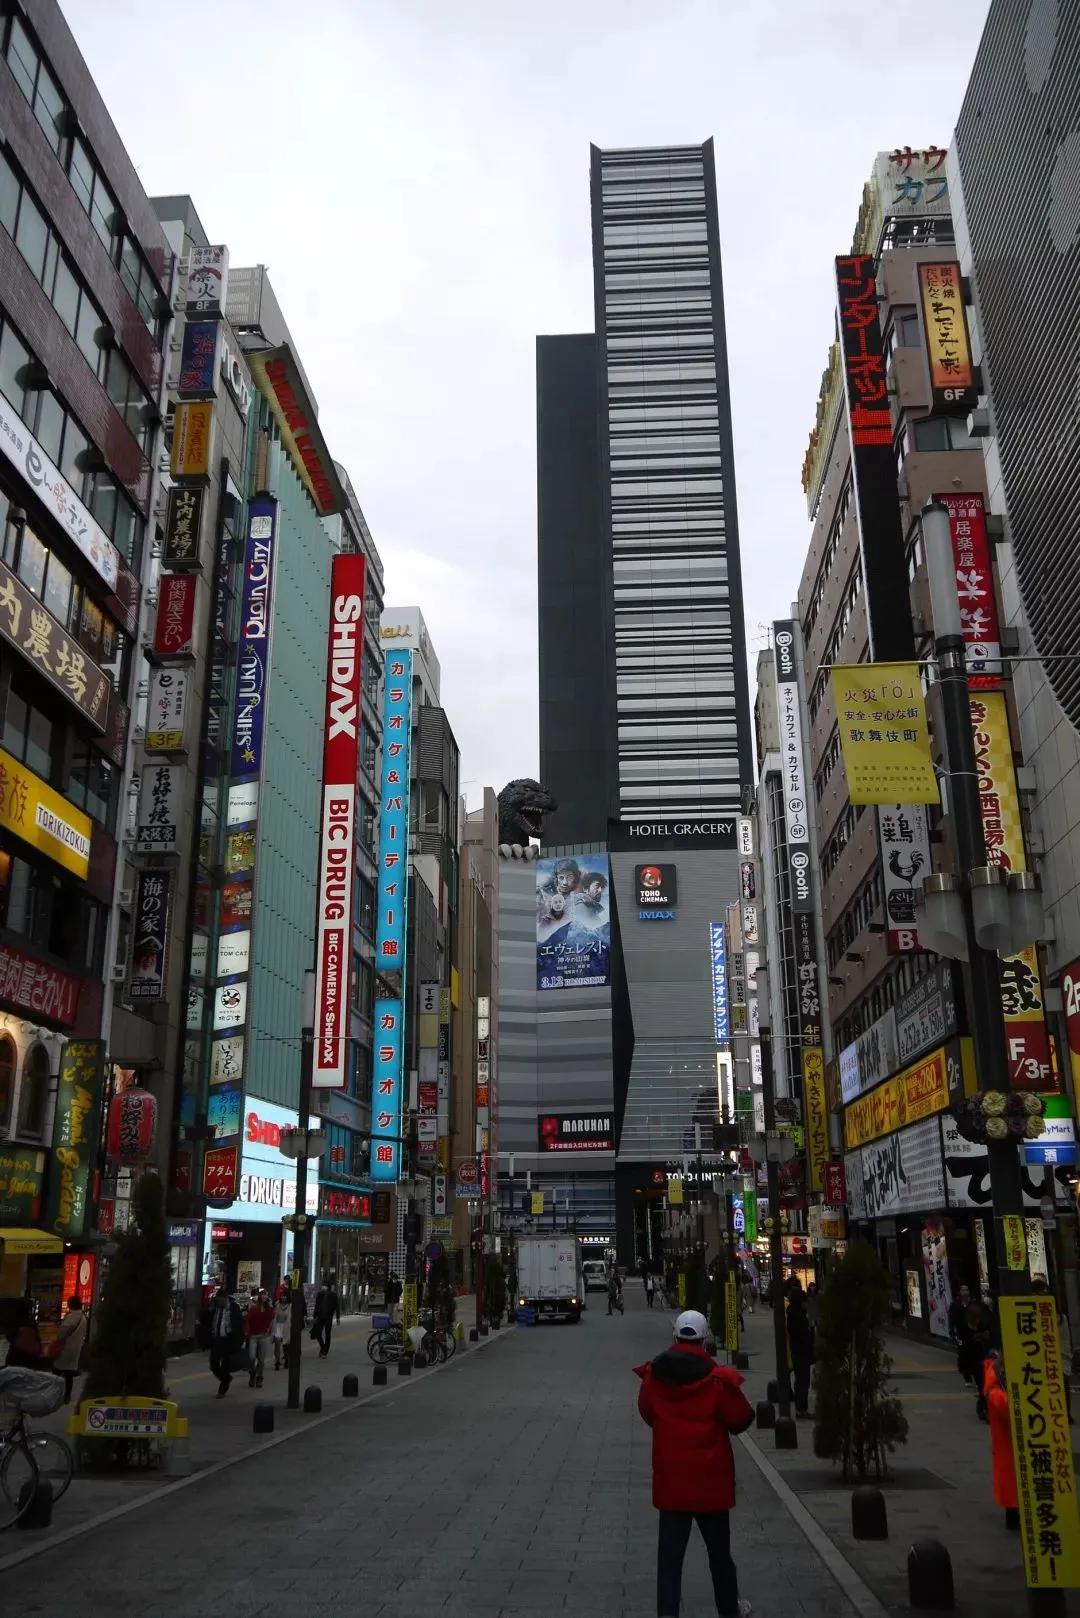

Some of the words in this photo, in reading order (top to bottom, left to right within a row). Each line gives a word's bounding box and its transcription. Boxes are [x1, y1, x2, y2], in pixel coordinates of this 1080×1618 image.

[196, 301, 209, 309] 8F
[944, 389, 964, 401] 6F
[955, 521, 975, 567] 居楽屋
[776, 631, 793, 674] Booth
[328, 594, 362, 741] SHIDAX
[236, 657, 261, 746] SHINJUKU
[156, 733, 176, 746] 3F
[850, 729, 918, 743] 歌舞伎町
[38, 807, 86, 853] TORIKIZOKU
[327, 799, 349, 841] BIC
[629, 824, 671, 836] HOTEL
[673, 823, 734, 835] GRACERY
[324, 848, 347, 920] DRUG
[791, 852, 809, 900] Booth
[639, 911, 674, 920] IMAX
[327, 932, 339, 952] BIC
[541, 941, 606, 956] エヴェレスト
[797, 961, 820, 1016] 甘太郎
[803, 1024, 821, 1034] 4F
[804, 1035, 821, 1046] 3F
[376, 1015, 395, 1162] カラオケ館
[562, 1118, 610, 1133] MARUHAN
[207, 1165, 233, 1176] アダム
[251, 1177, 282, 1205] DRUG
